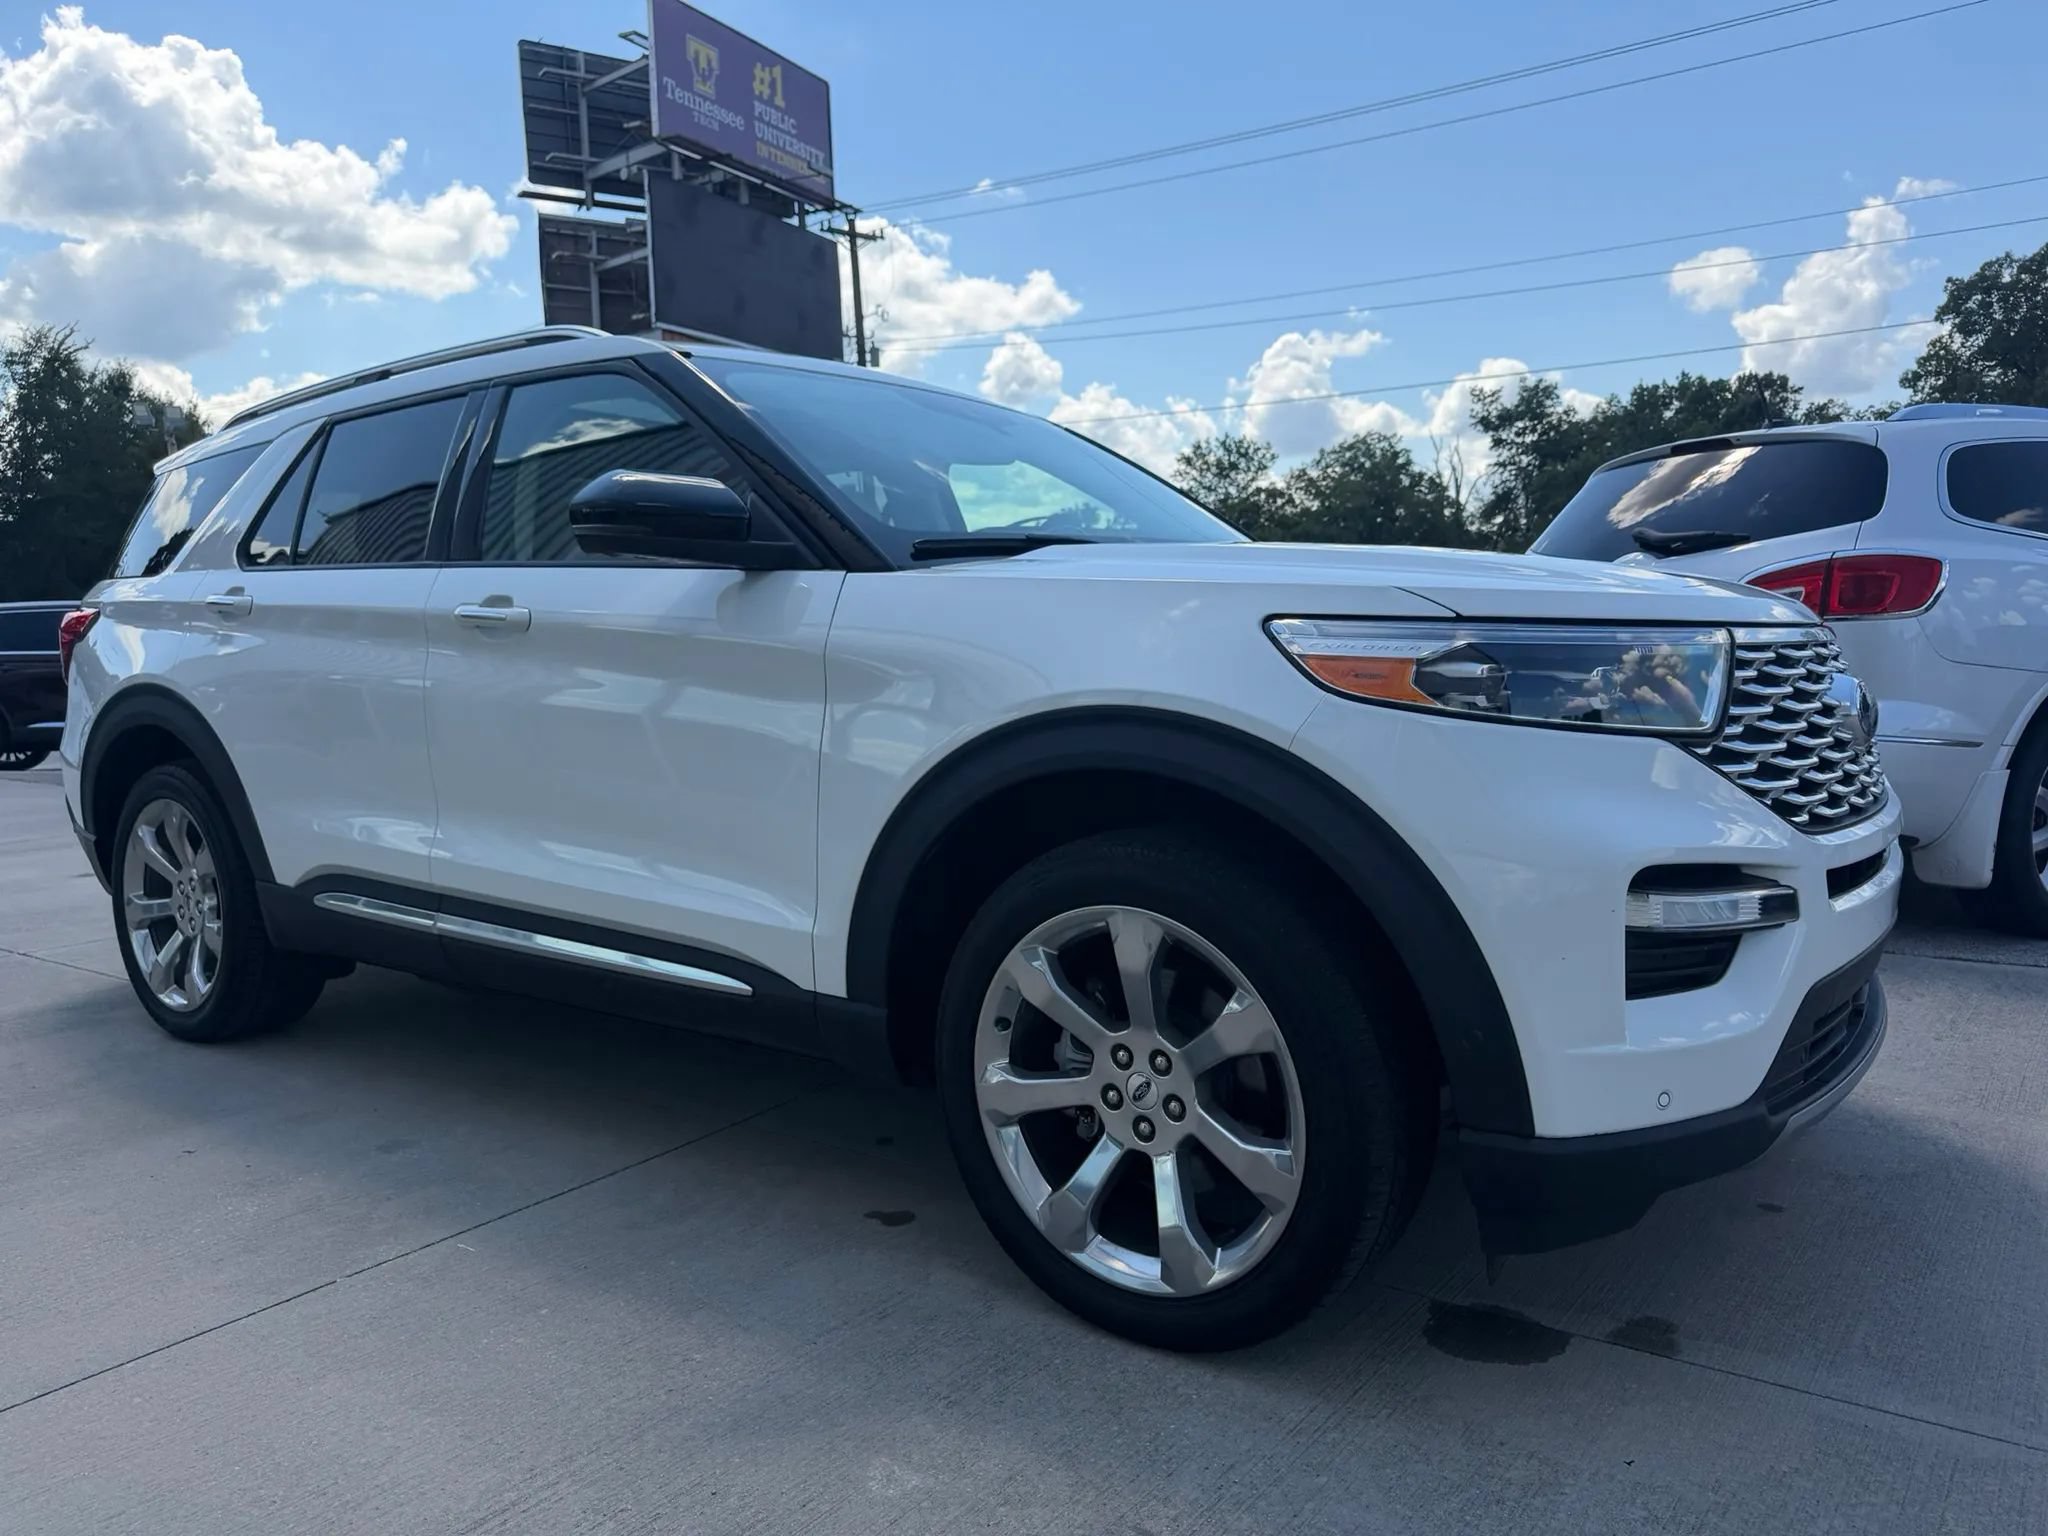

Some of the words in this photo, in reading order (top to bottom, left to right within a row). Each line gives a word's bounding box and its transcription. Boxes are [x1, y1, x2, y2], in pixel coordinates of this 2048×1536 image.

[663, 77, 745, 130] Tennessee
[753, 62, 785, 109] #1
[692, 111, 719, 131] TECH
[754, 101, 797, 134] PUBLIC
[754, 120, 825, 165] UNIVERSITY
